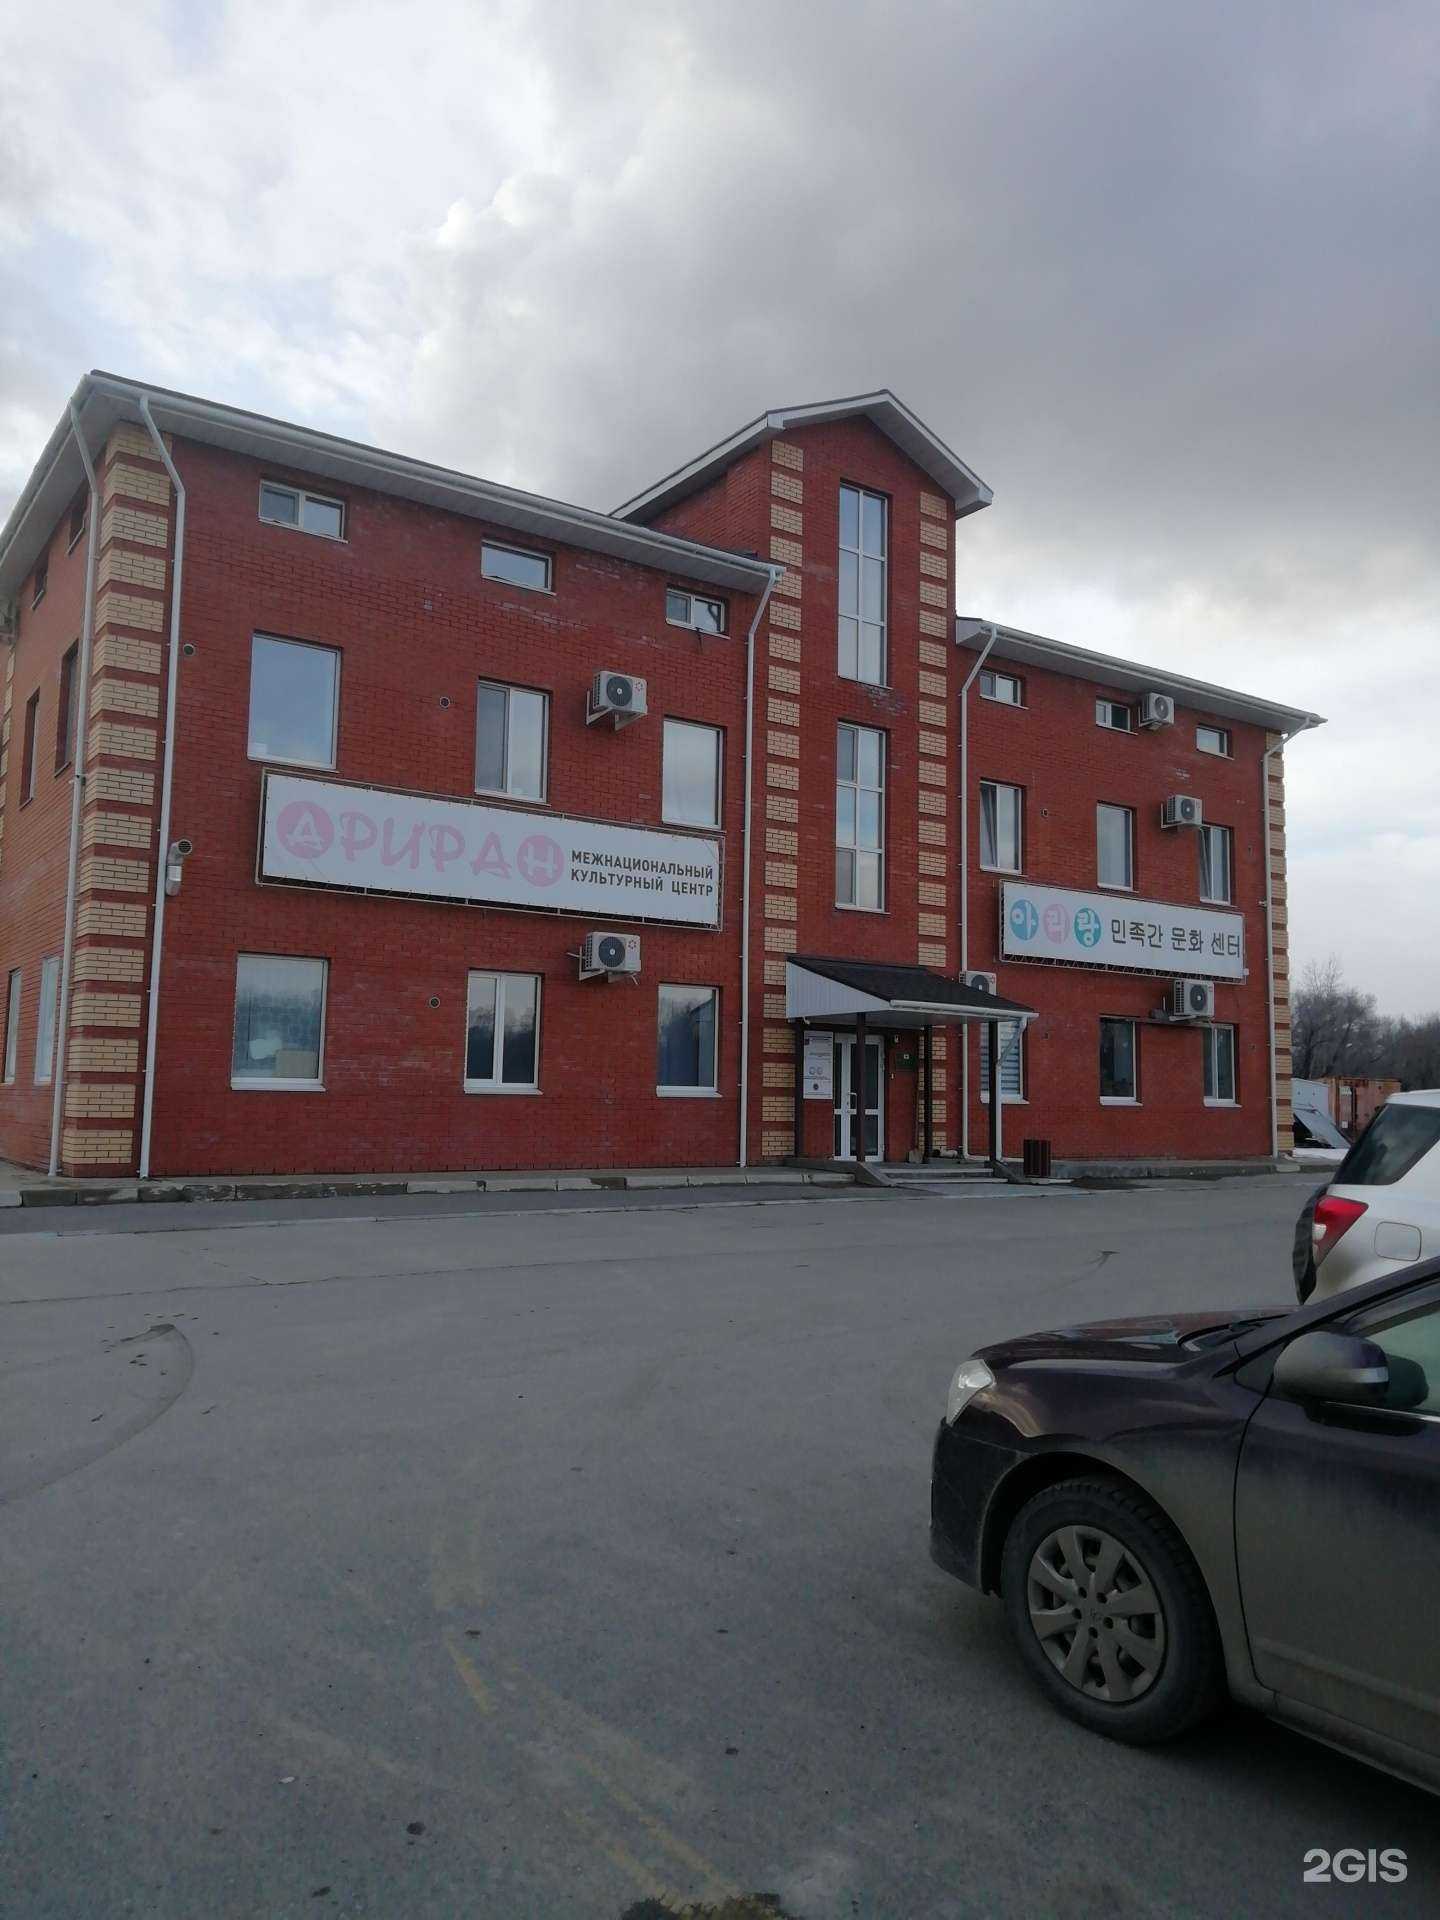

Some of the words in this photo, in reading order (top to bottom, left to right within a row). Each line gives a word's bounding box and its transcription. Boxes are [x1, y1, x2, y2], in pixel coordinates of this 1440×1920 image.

[571, 849, 713, 880] МЕЖНАЦИОНАЛЬНЫЙ
[571, 868, 664, 892] КУЛЬТУРНЫЙ
[671, 880, 713, 897] ЦЕНТР
[1111, 919, 1163, 949] 민족간
[1171, 926, 1204, 954] 문화
[1211, 932, 1240, 958] 센터
